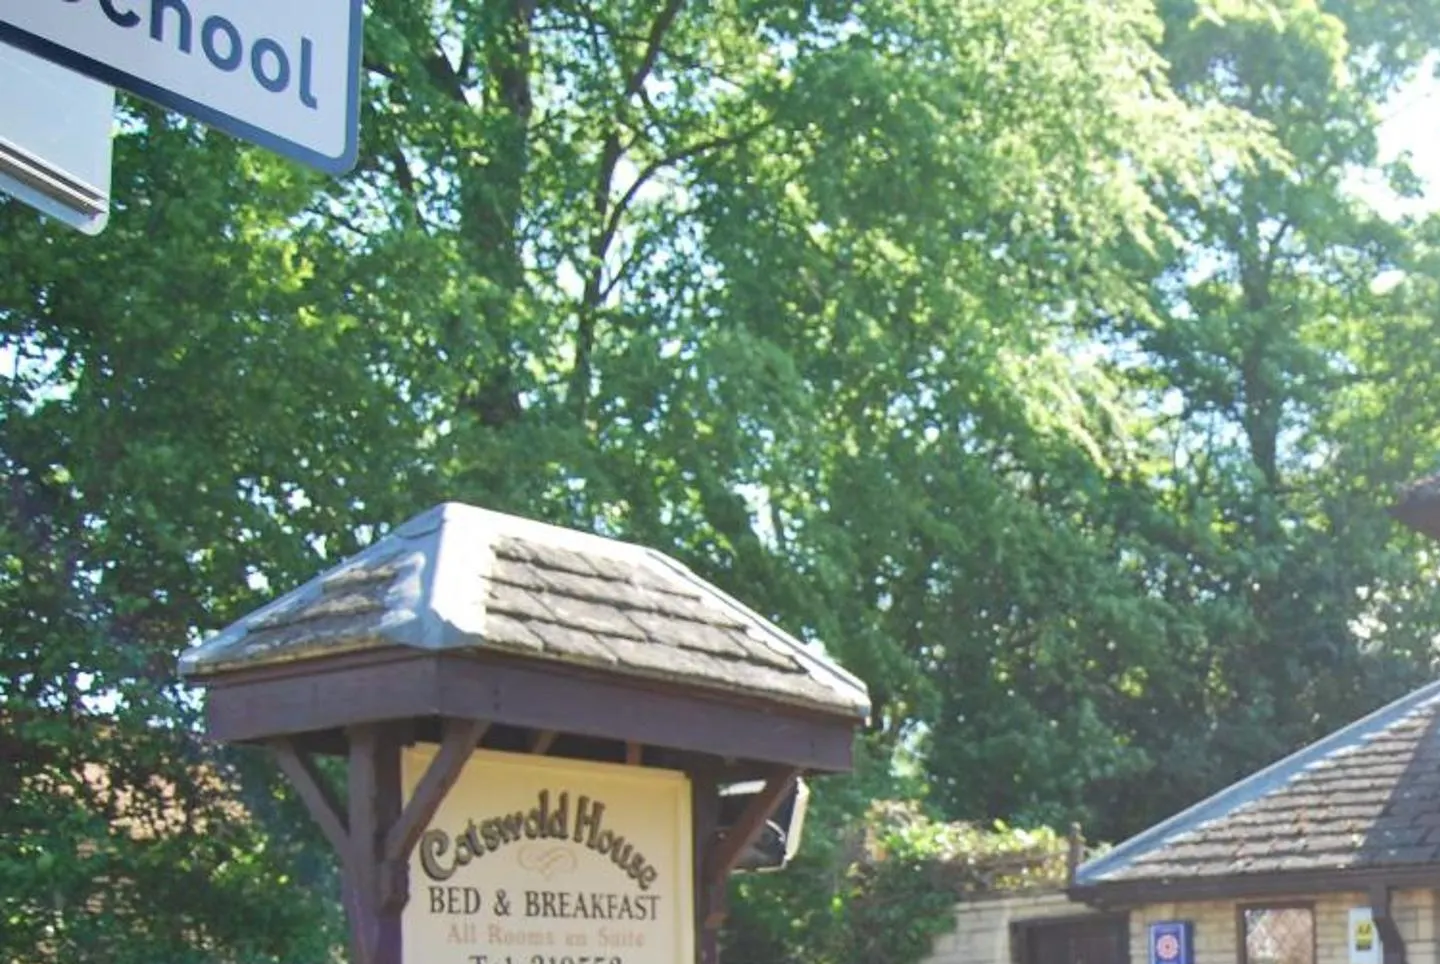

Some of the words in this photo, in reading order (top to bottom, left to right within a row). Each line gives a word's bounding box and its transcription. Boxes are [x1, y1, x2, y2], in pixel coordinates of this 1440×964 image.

[62, 0, 318, 110] chool
[420, 788, 569, 881] Cotswold
[573, 794, 658, 891] House
[428, 885, 481, 915] BED
[493, 888, 512, 918] &
[525, 890, 661, 921] BREAKFAST
[447, 921, 477, 945] All
[488, 923, 556, 946] Rooms
[598, 925, 646, 948] Suite
